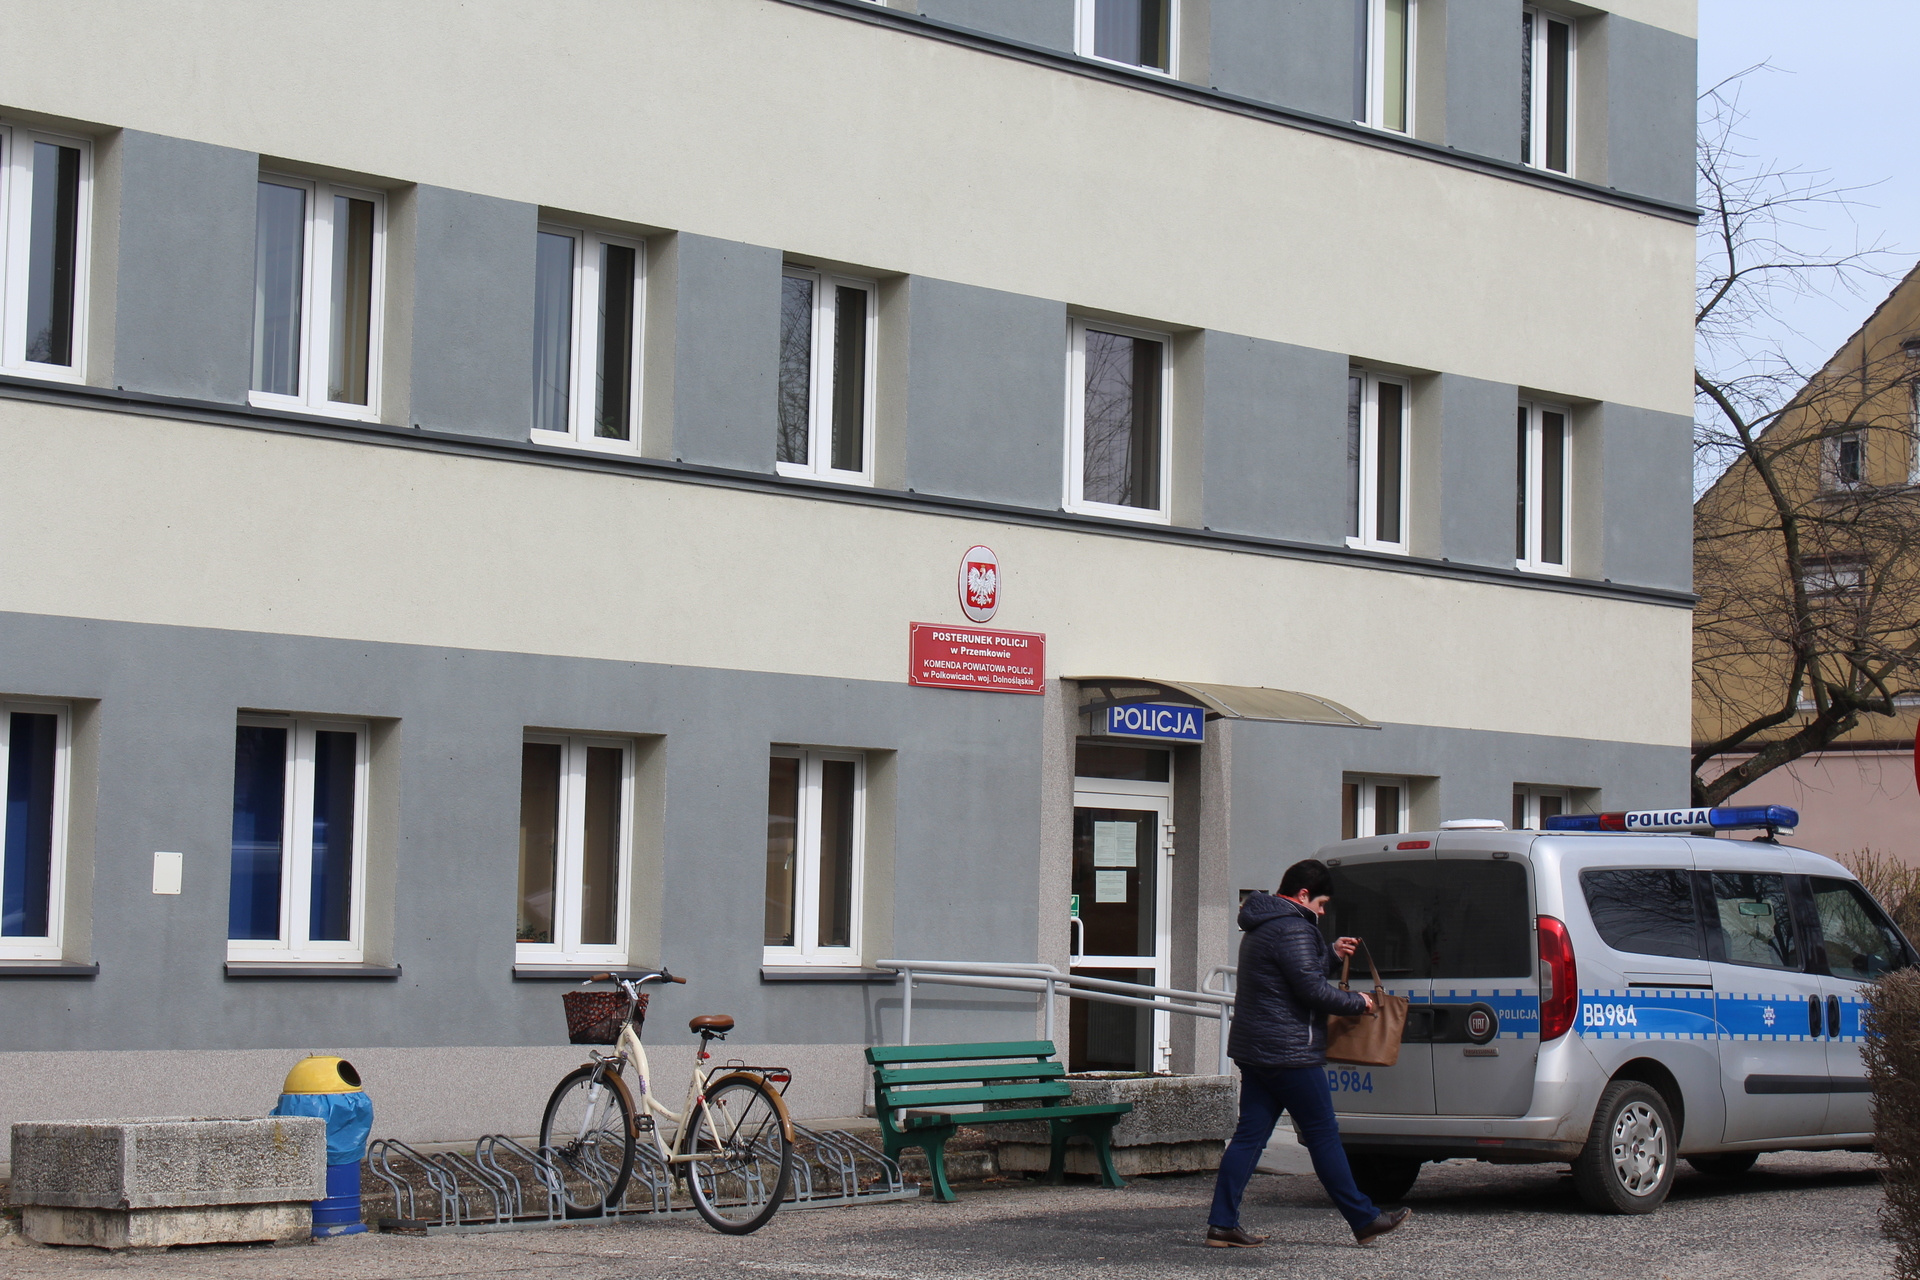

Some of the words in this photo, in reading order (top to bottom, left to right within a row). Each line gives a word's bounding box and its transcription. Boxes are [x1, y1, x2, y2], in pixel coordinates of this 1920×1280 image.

[932, 631, 993, 645] POSTERUNEK
[995, 636, 1028, 648] POLICJI
[960, 646, 1011, 659] Przemkowie
[923, 659, 961, 670] KOMENDA
[962, 662, 1006, 673] POWIATOWA
[1007, 665, 1034, 675] POLICJI
[930, 670, 976, 682] Polkowicach,
[977, 675, 991, 685] woj.
[992, 674, 1034, 687] Dolnośląskie
[1113, 706, 1198, 735] POLICJA
[1626, 811, 1708, 828] POLICJA
[1499, 1009, 1538, 1020] POLICJA
[1583, 1003, 1638, 1027] BB984
[1472, 1018, 1486, 1030] FIAT
